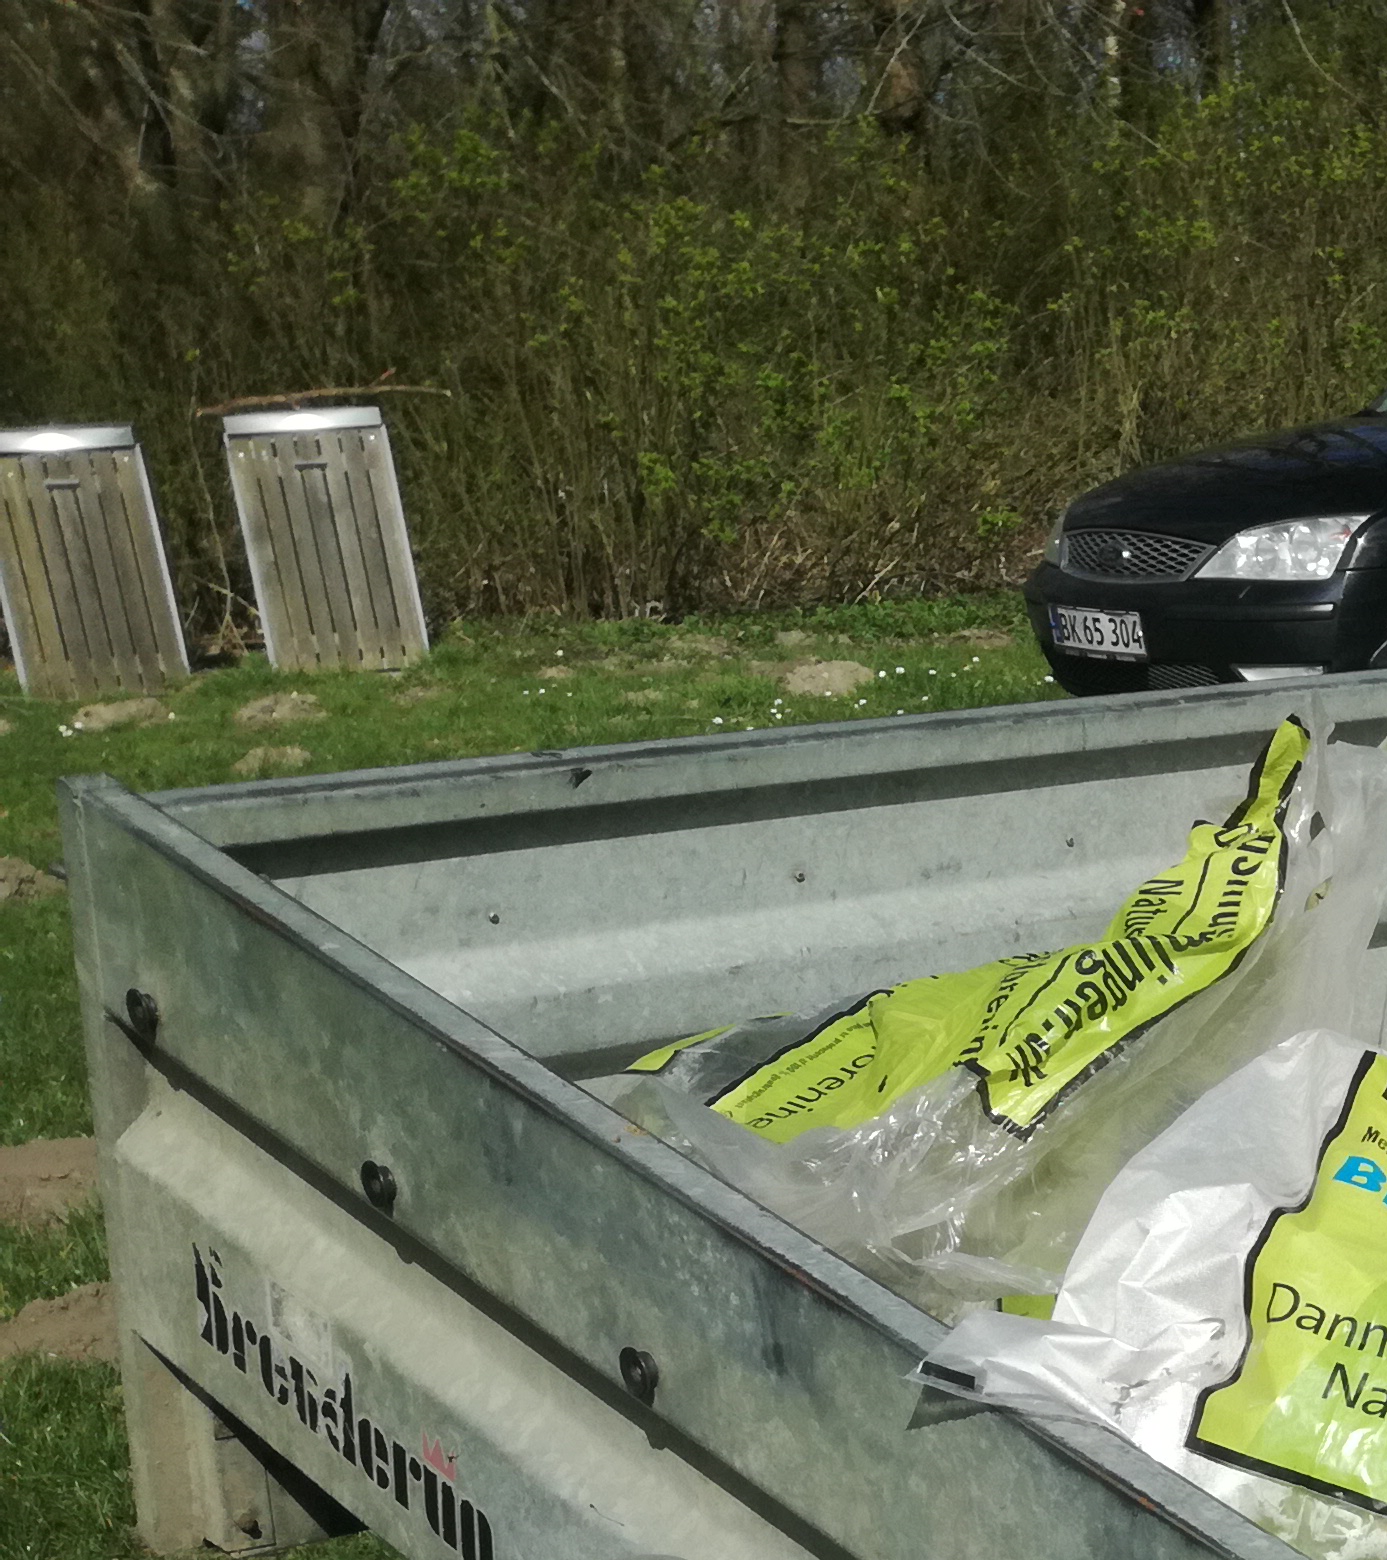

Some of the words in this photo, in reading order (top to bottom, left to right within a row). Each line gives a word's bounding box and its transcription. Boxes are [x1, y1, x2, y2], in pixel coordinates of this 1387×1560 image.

[1059, 612, 1082, 644] BK
[1083, 615, 1104, 646] 65
[1107, 617, 1143, 649] 304
